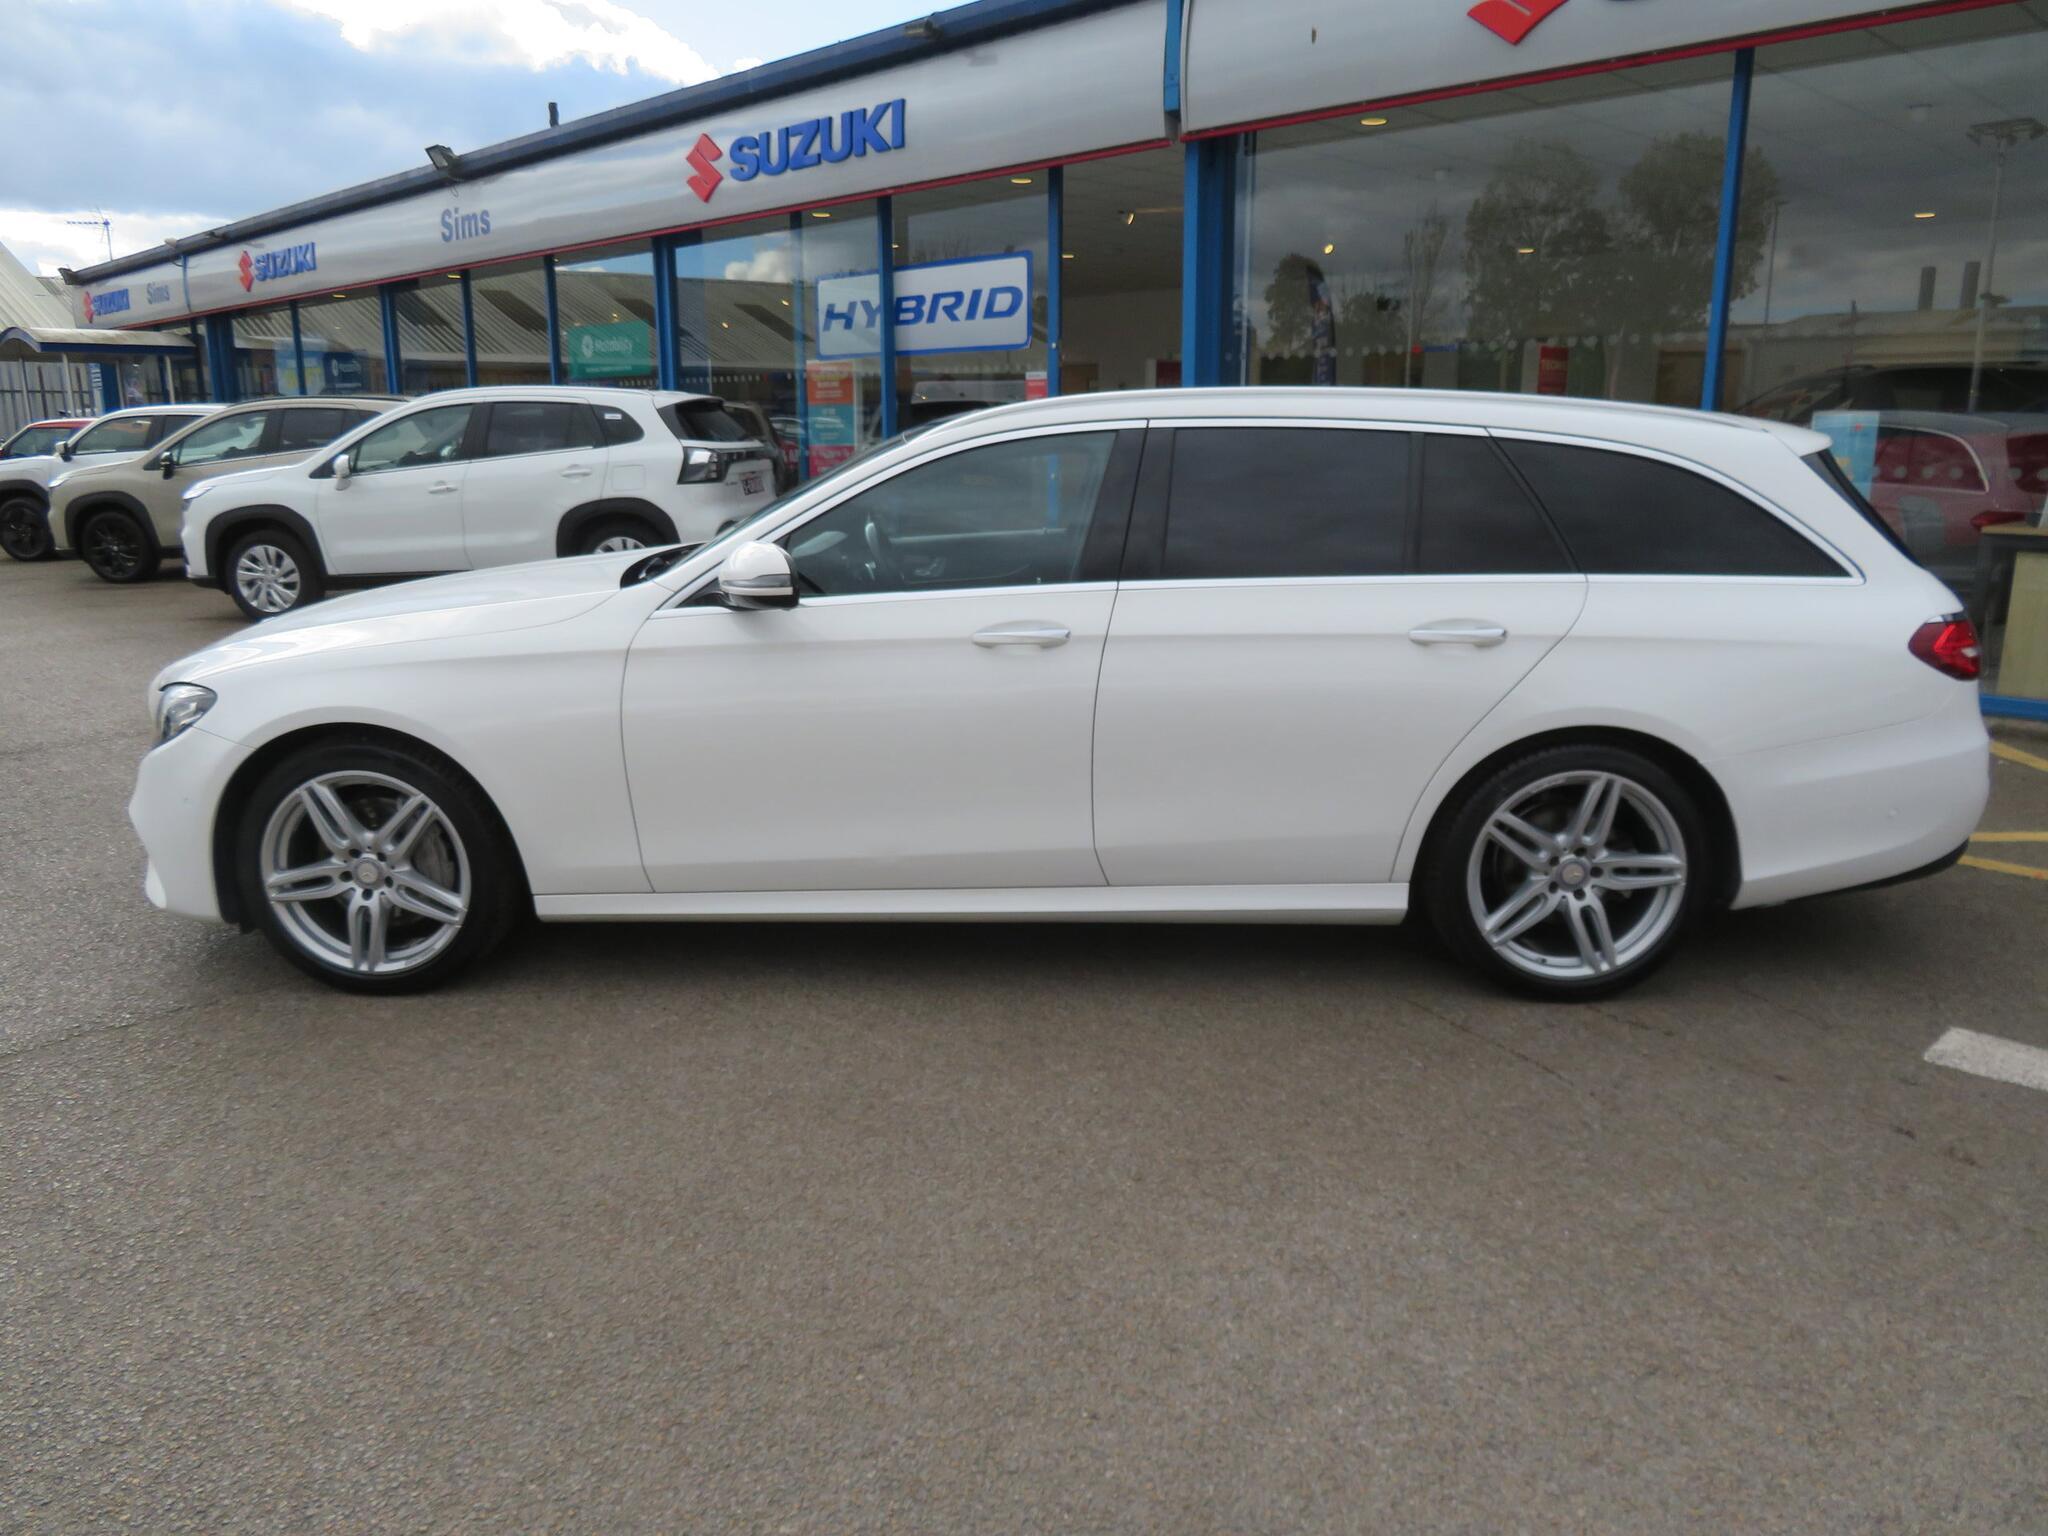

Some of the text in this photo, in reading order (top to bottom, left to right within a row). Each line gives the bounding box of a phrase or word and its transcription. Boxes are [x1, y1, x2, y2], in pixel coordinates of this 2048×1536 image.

[729, 98, 906, 182] SUZUKI
[441, 207, 491, 243] Sims
[255, 242, 317, 281] SUZUKI
[822, 286, 1023, 332] HYBRID
